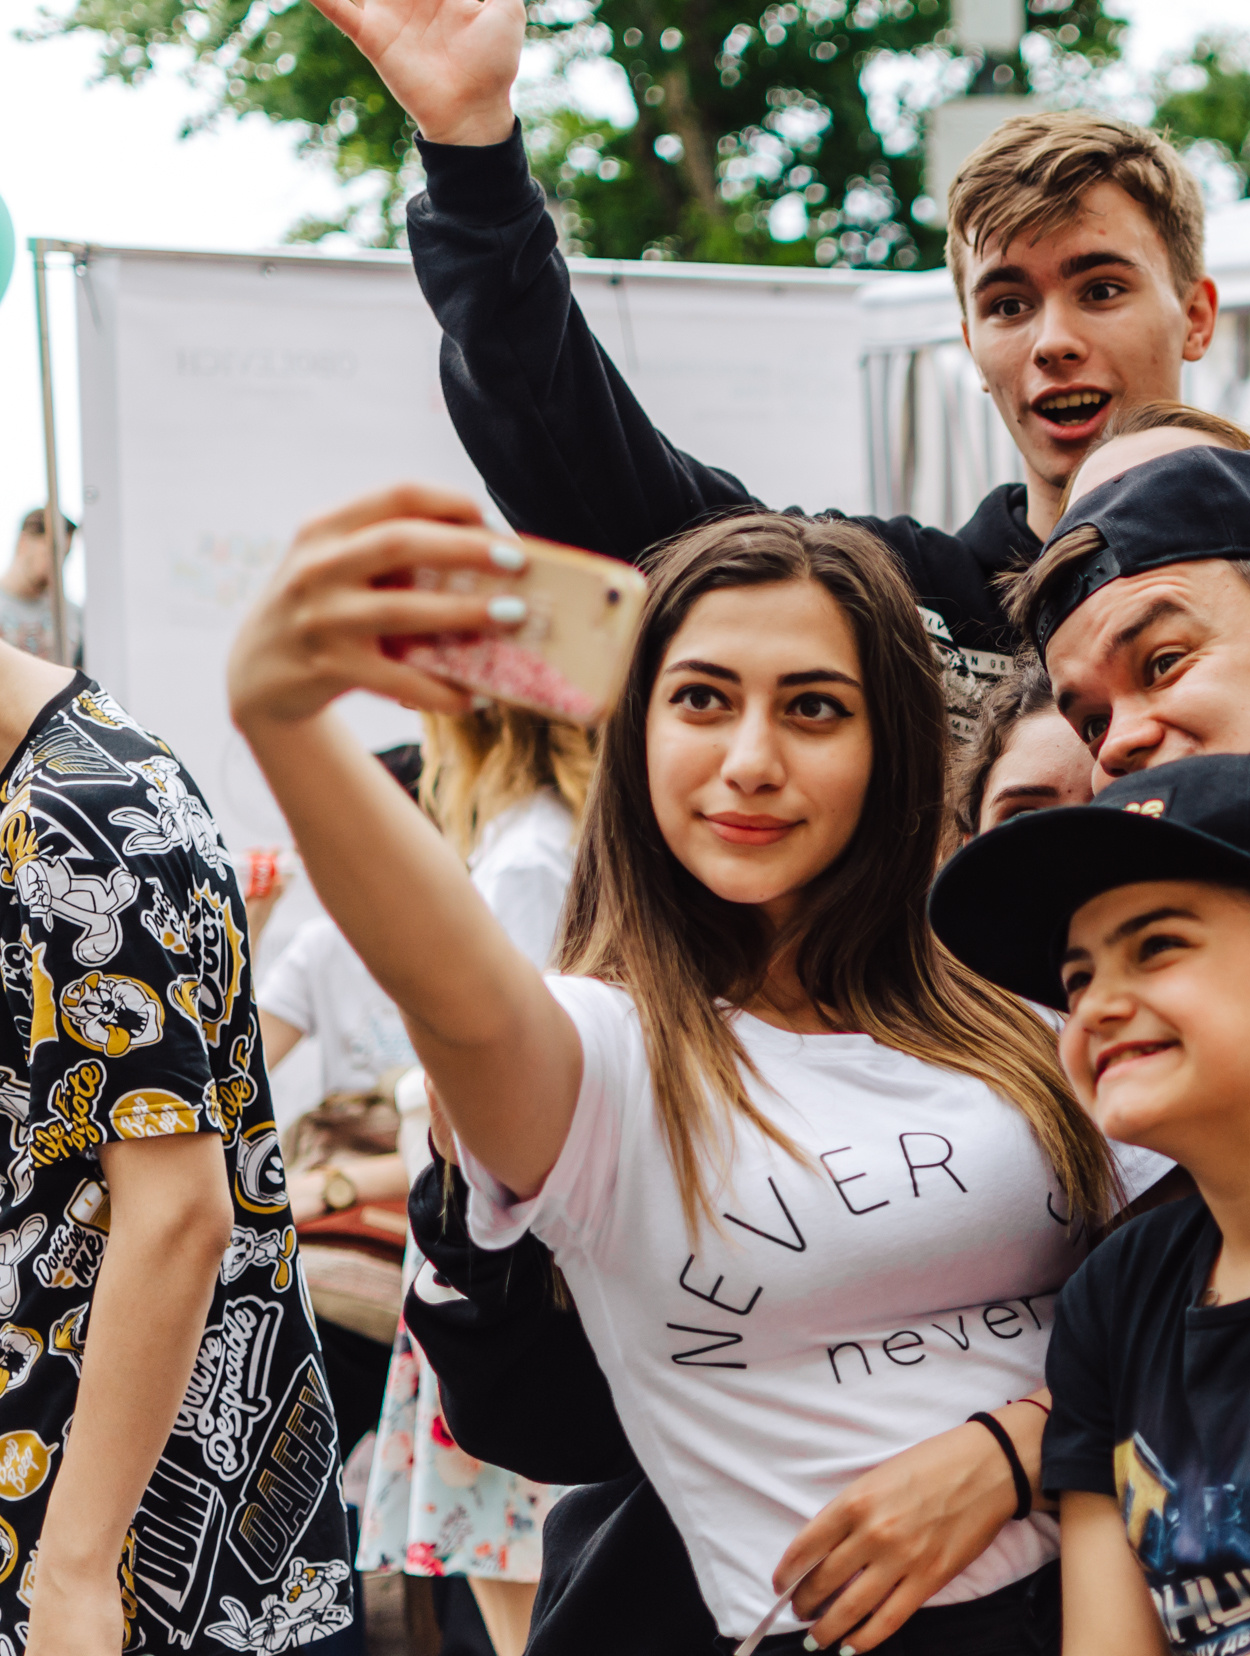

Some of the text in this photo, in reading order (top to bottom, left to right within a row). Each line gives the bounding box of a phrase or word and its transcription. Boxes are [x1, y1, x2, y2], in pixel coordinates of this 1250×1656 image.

[666, 1131, 968, 1369] NEVER
[208, 1307, 259, 1473] Despicable
[826, 1297, 1044, 1385] never
